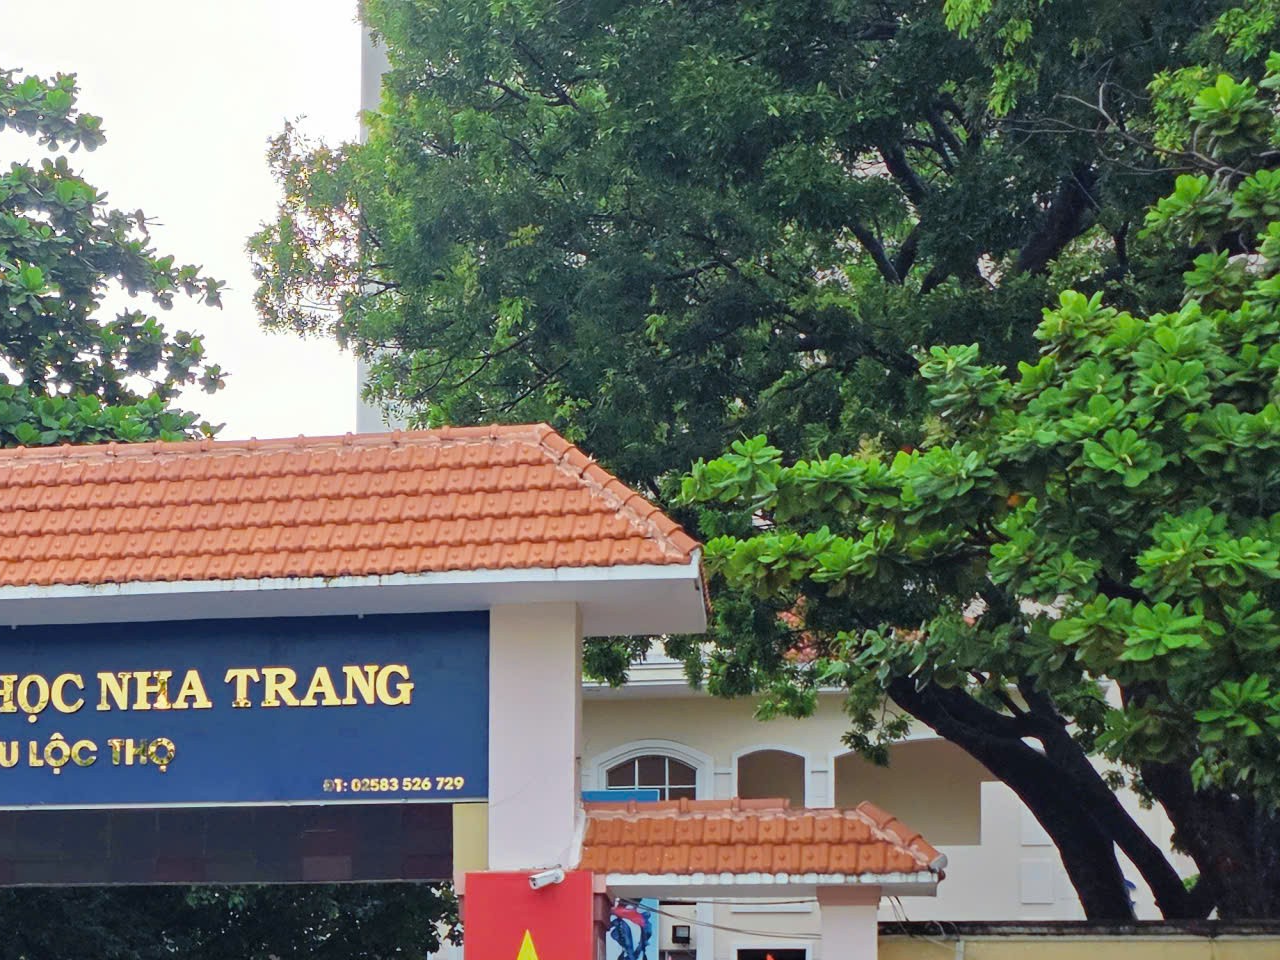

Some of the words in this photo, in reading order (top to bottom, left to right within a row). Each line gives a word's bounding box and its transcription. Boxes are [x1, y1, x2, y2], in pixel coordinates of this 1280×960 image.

[96, 669, 213, 712] NHA
[224, 664, 415, 709] TRANG
[28, 732, 98, 775] LỘC
[107, 737, 176, 773] THỌ
[351, 778, 399, 792] 02583
[402, 777, 432, 791] 526
[435, 776, 465, 791] 729
